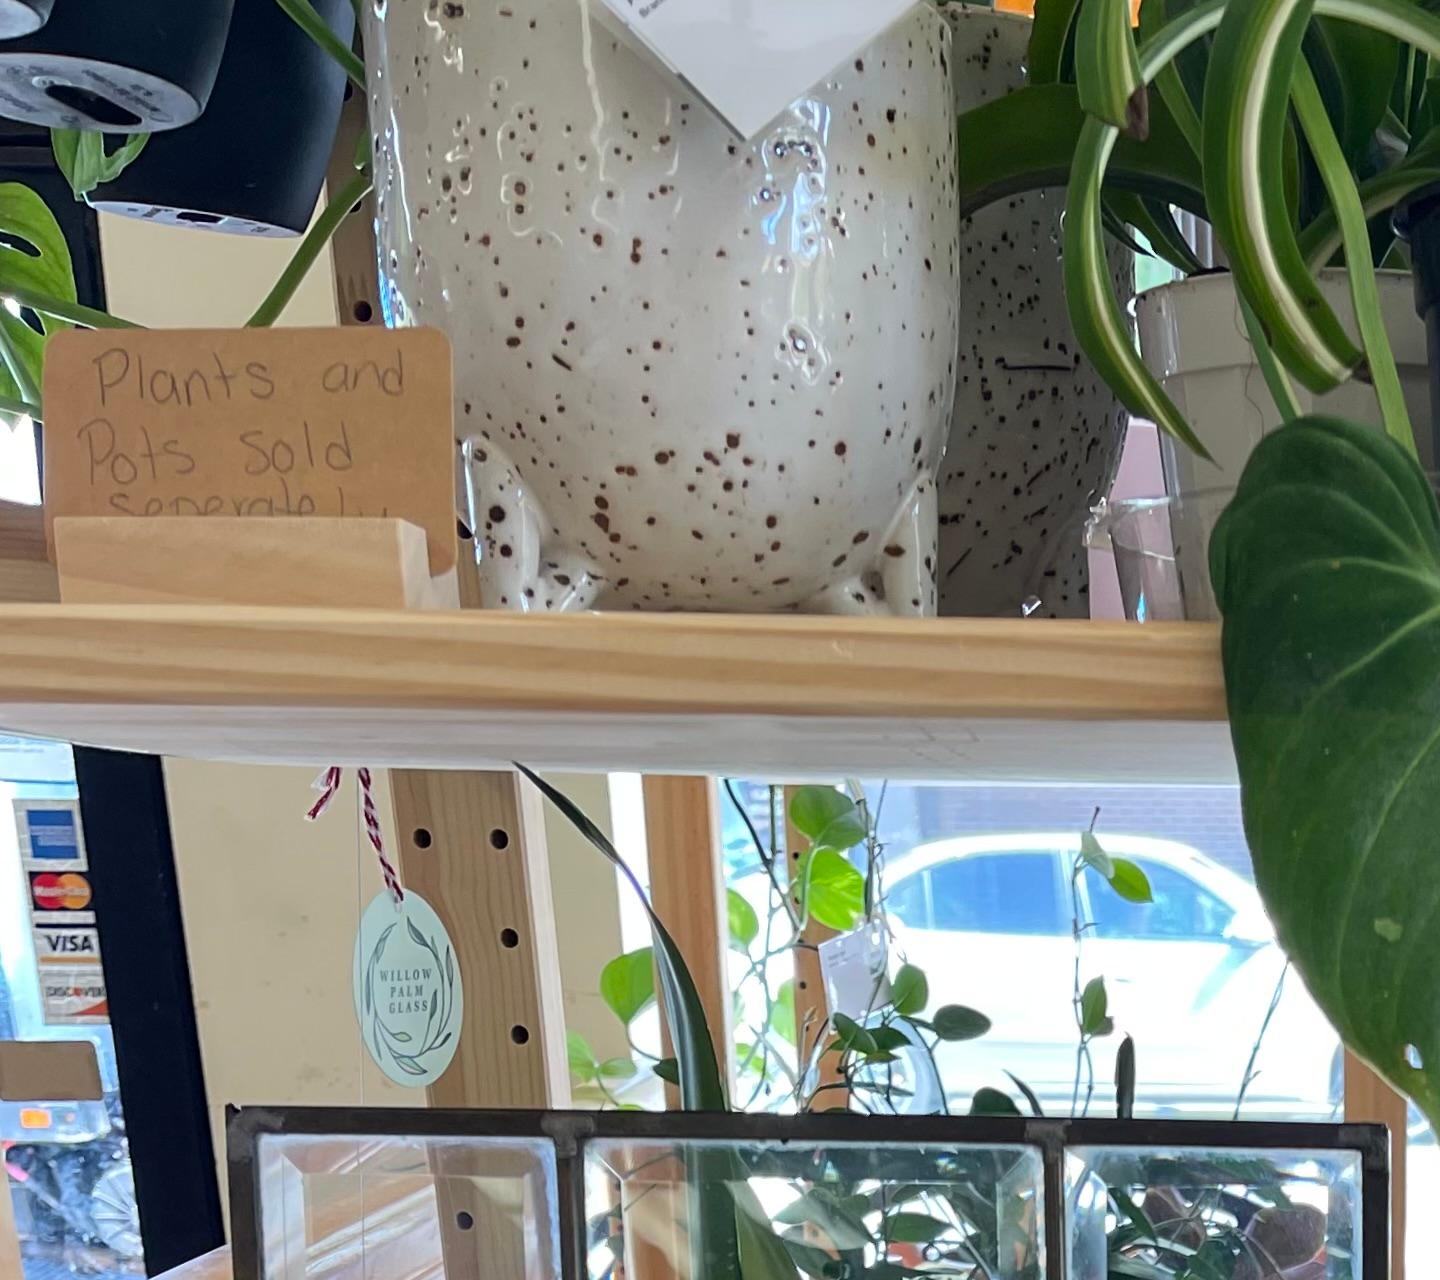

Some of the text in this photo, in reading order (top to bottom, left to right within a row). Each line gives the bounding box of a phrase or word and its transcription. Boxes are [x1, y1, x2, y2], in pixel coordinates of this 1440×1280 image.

[92, 347, 405, 406] Plants and
[77, 417, 196, 485] Pots
[45, 934, 95, 951] VISA
[379, 968, 432, 982] WILLOW
[390, 984, 424, 998] PALM
[388, 1000, 429, 1014] GLASS
